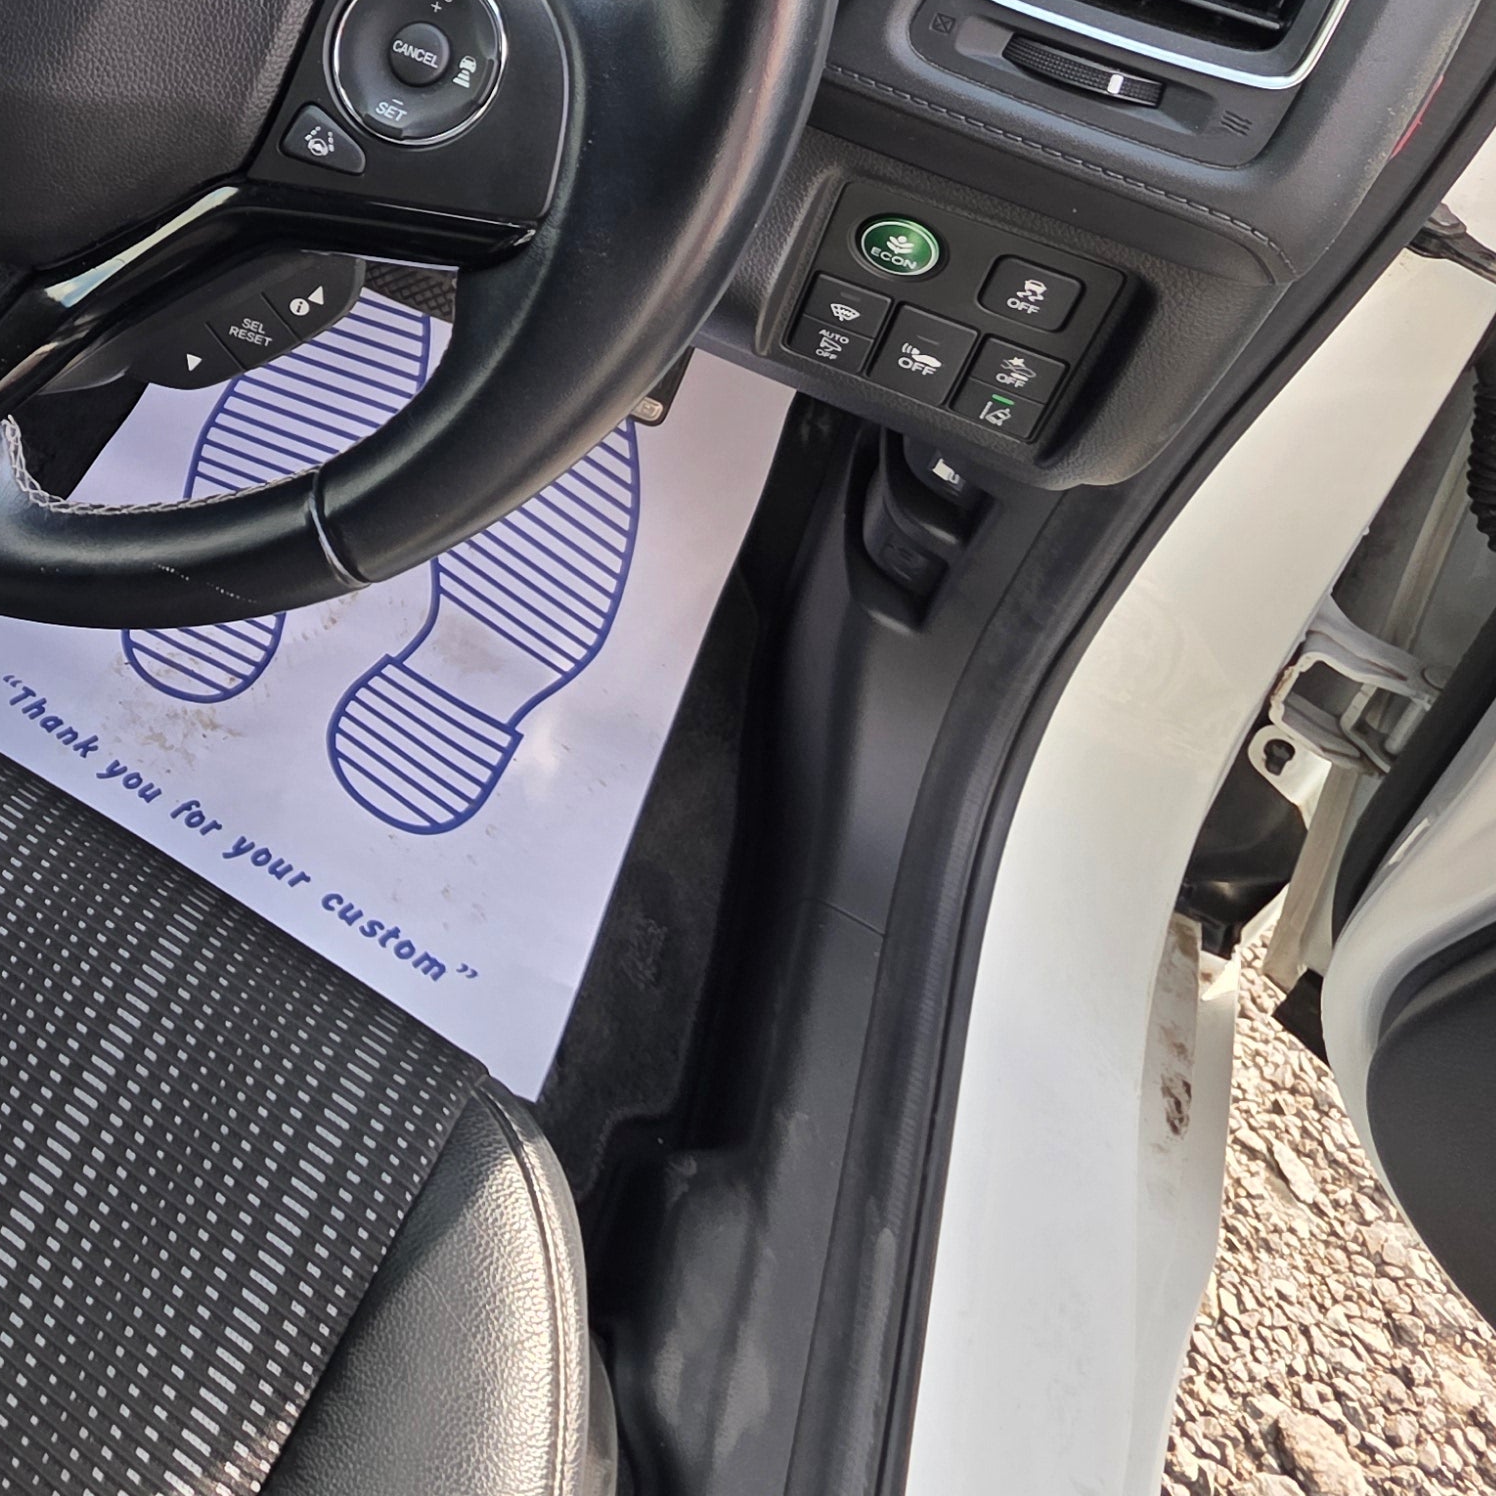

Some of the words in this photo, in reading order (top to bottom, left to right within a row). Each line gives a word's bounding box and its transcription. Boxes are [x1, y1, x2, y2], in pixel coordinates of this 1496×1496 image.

[391, 39, 439, 70] CANCEL
[375, 101, 408, 123] SET
[870, 246, 917, 271] ECON
[1006, 297, 1041, 315] OFF
[228, 325, 273, 348] RESET
[241, 317, 267, 336] SEL
[818, 328, 850, 346] AUTO
[815, 348, 838, 361] OFF
[897, 355, 937, 377] OFF
[995, 372, 1026, 389] OFF
[2, 673, 100, 760] “Thank
[95, 757, 164, 805] you
[169, 798, 224, 838] for
[220, 835, 313, 889] your
